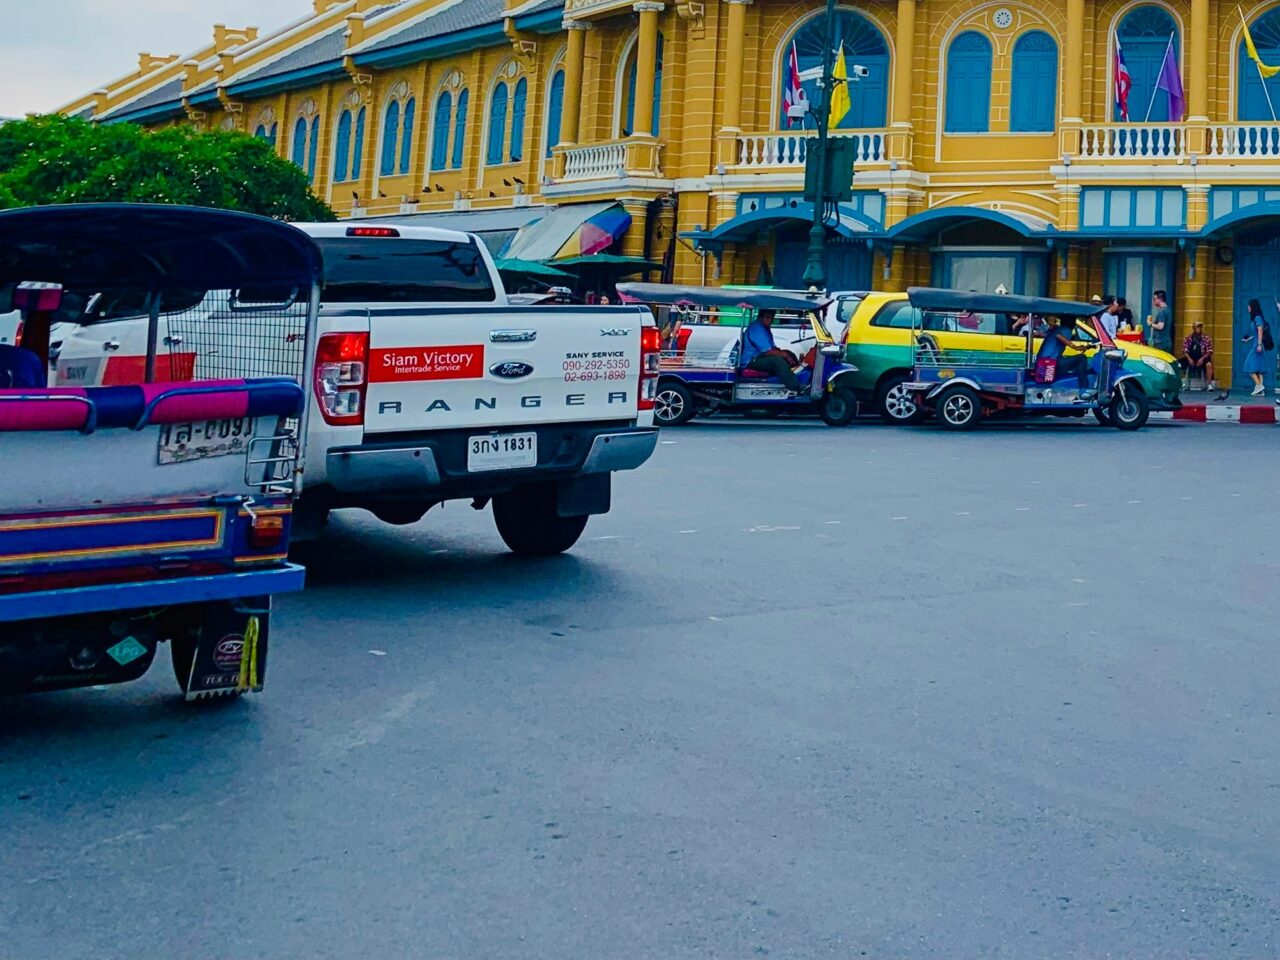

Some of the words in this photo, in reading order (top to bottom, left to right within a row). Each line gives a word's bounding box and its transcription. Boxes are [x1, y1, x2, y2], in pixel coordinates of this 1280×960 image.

[383, 353, 418, 367] Siam
[423, 351, 474, 367] Victory
[591, 351, 625, 359] SERVICE
[395, 365, 432, 374] Intertrade
[434, 364, 461, 372] Service
[501, 363, 525, 375] Ford
[562, 359, 630, 371] 090-292-5350
[564, 371, 626, 382] 02-693-1898
[378, 392, 628, 414] RANGER
[472, 439, 499, 454] 3กง
[504, 437, 532, 452] 1831
